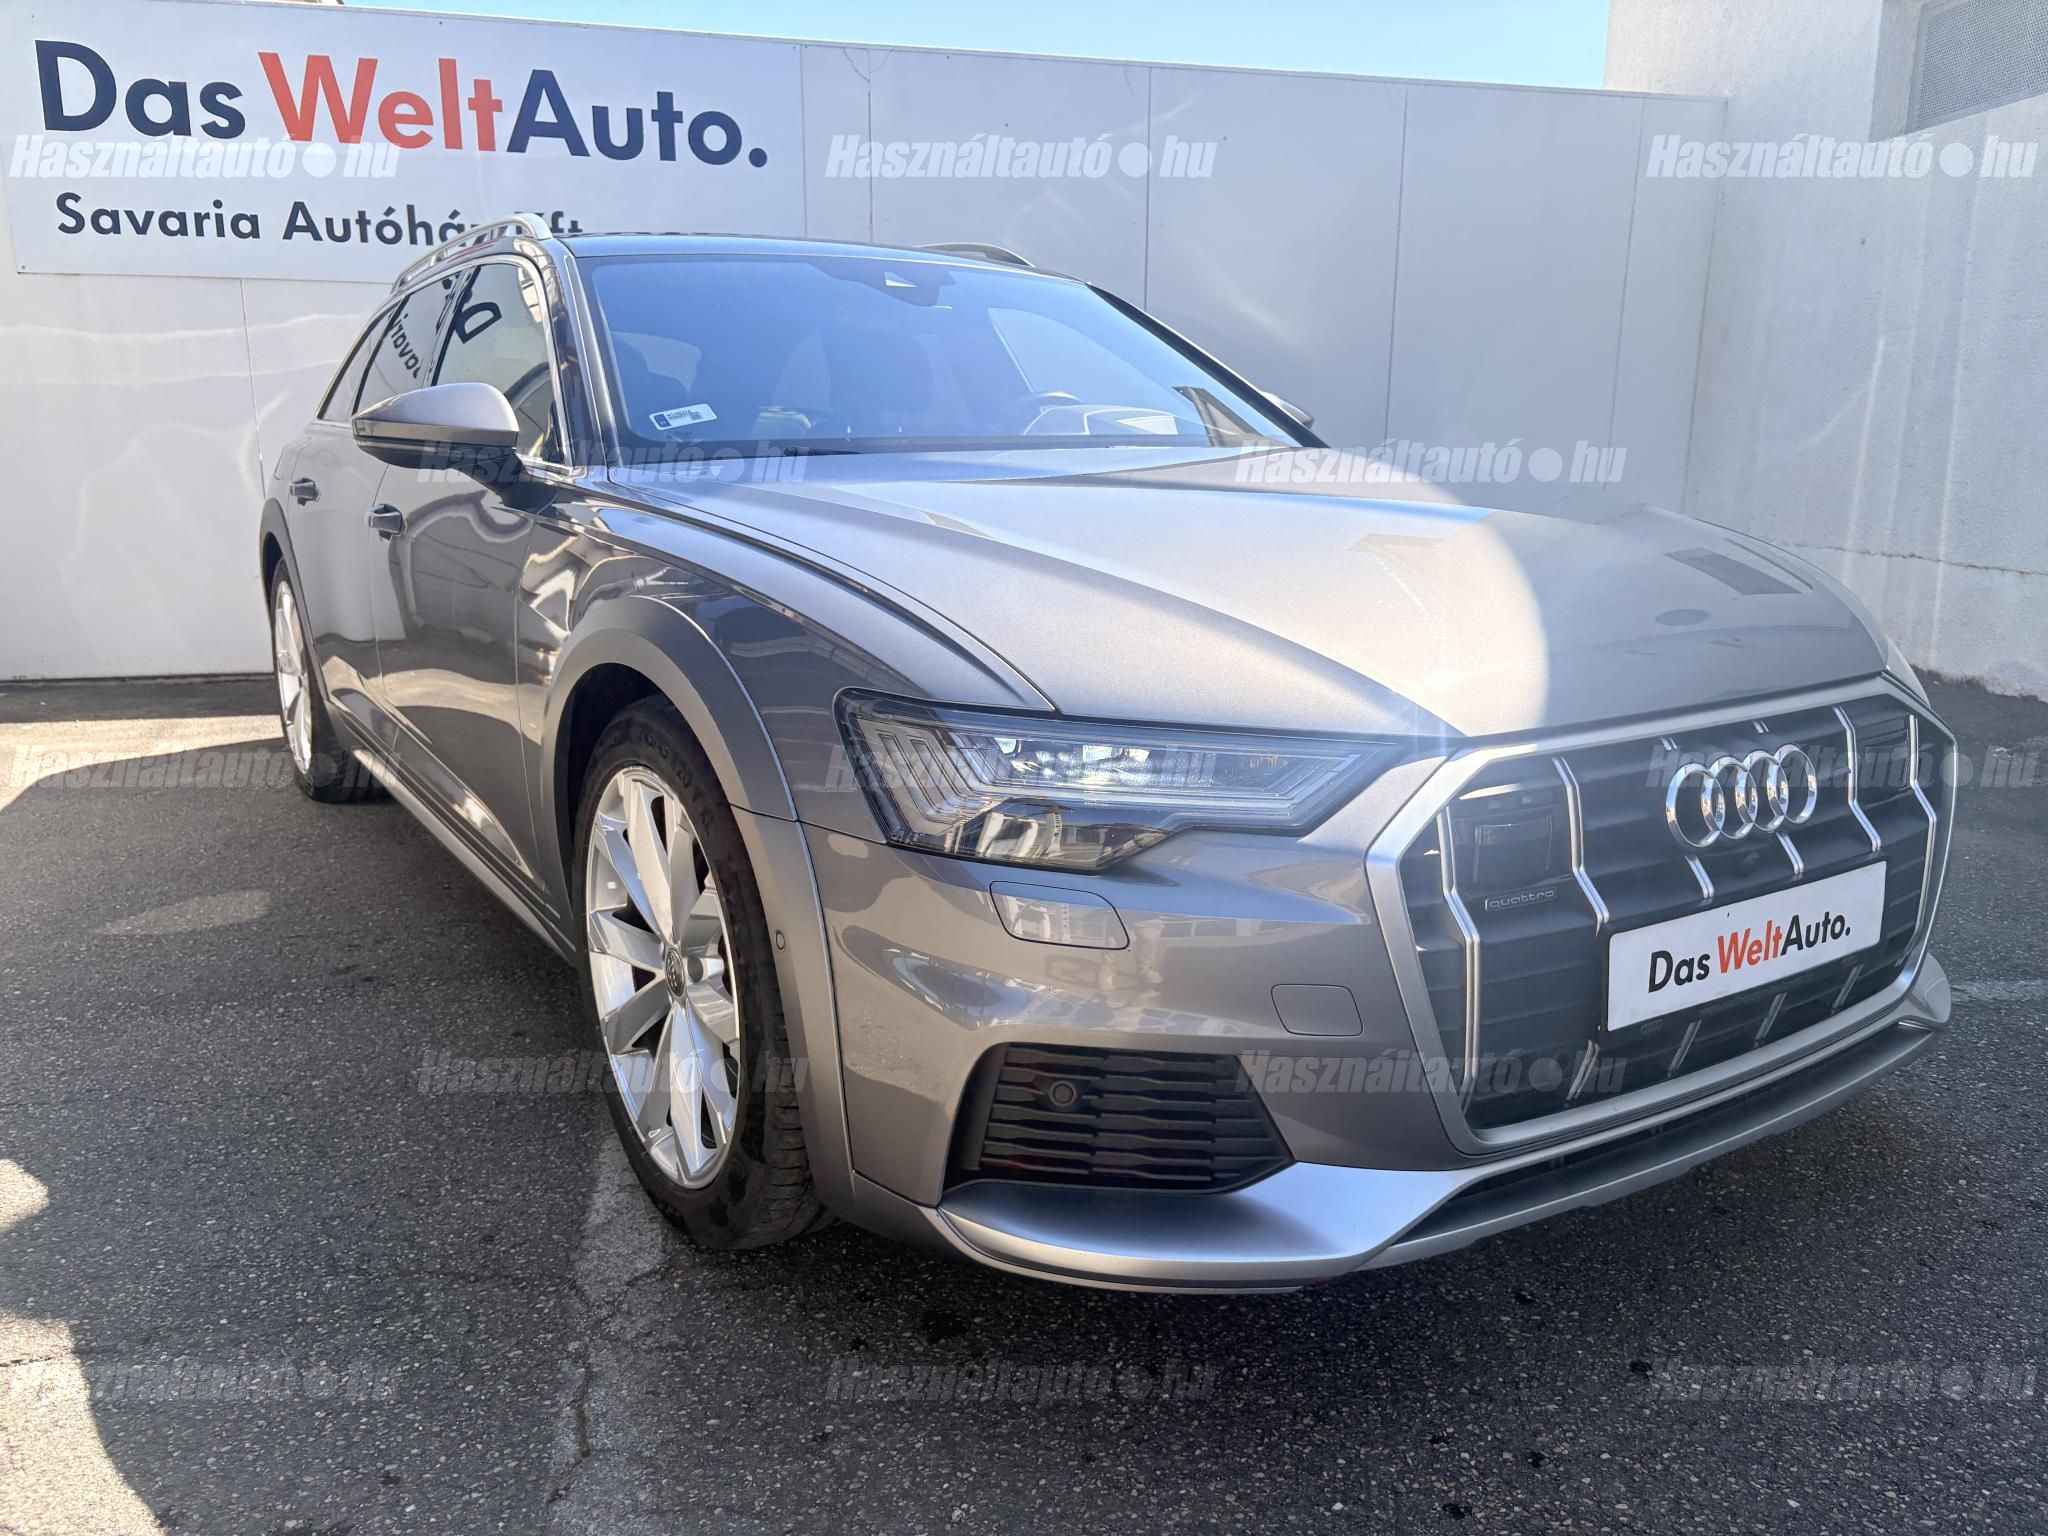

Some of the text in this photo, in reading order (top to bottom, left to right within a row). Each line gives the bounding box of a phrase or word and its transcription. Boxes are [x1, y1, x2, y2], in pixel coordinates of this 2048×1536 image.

[34, 39, 769, 169] Das WeltAuto.
[56, 191, 261, 240] Savaria
[1489, 890, 1554, 909] quattro
[1648, 911, 1851, 993] Das WeltAuto.
